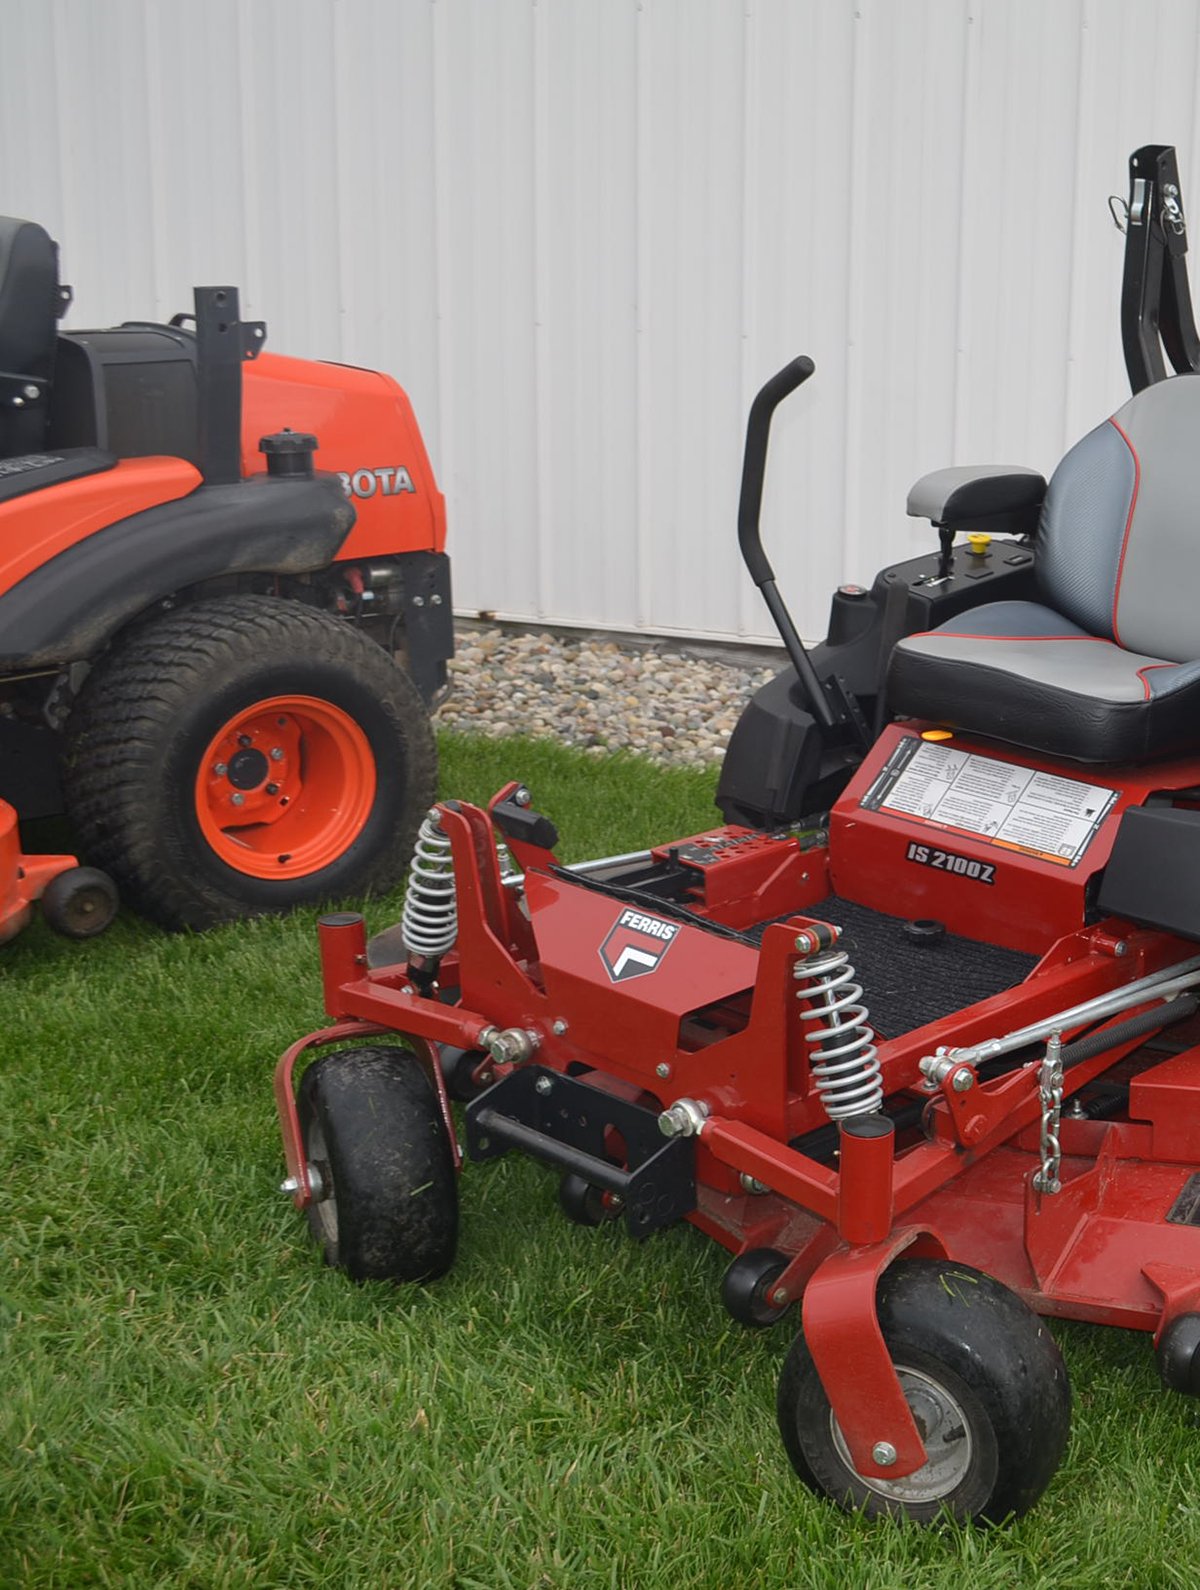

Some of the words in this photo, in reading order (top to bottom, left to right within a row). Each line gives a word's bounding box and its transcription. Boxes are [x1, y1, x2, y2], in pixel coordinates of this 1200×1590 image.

[906, 843, 930, 863] IS
[931, 851, 996, 883] 2100Z
[619, 910, 676, 940] FERRIS
